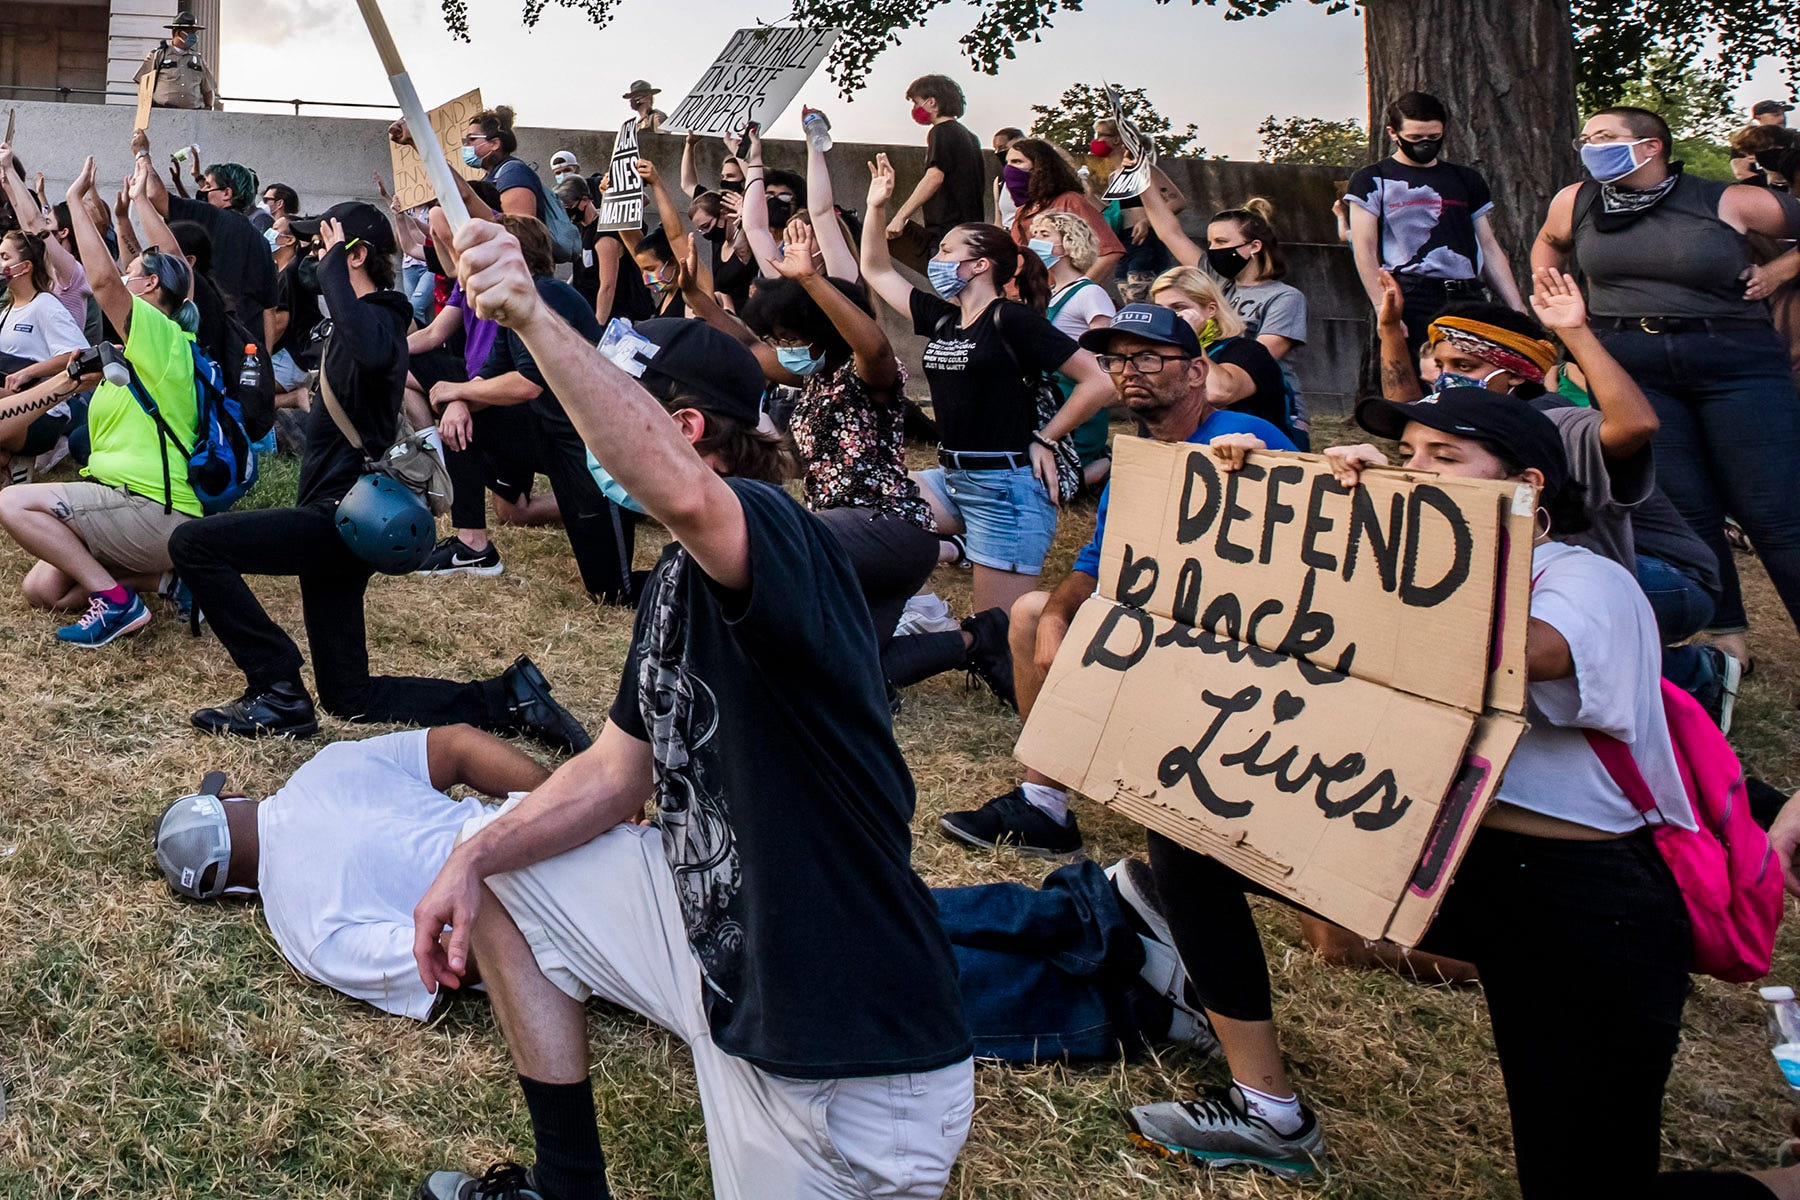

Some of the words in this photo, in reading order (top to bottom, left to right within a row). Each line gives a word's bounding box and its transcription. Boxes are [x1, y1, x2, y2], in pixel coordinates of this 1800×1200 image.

[669, 94, 765, 133] TROOPERS
[697, 66, 731, 92] TN
[724, 65, 784, 96] STATE
[600, 199, 641, 224] MATTER
[1176, 451, 1473, 607] DEFEND
[1082, 544, 1356, 685] Black
[1158, 684, 1413, 831] Lives
